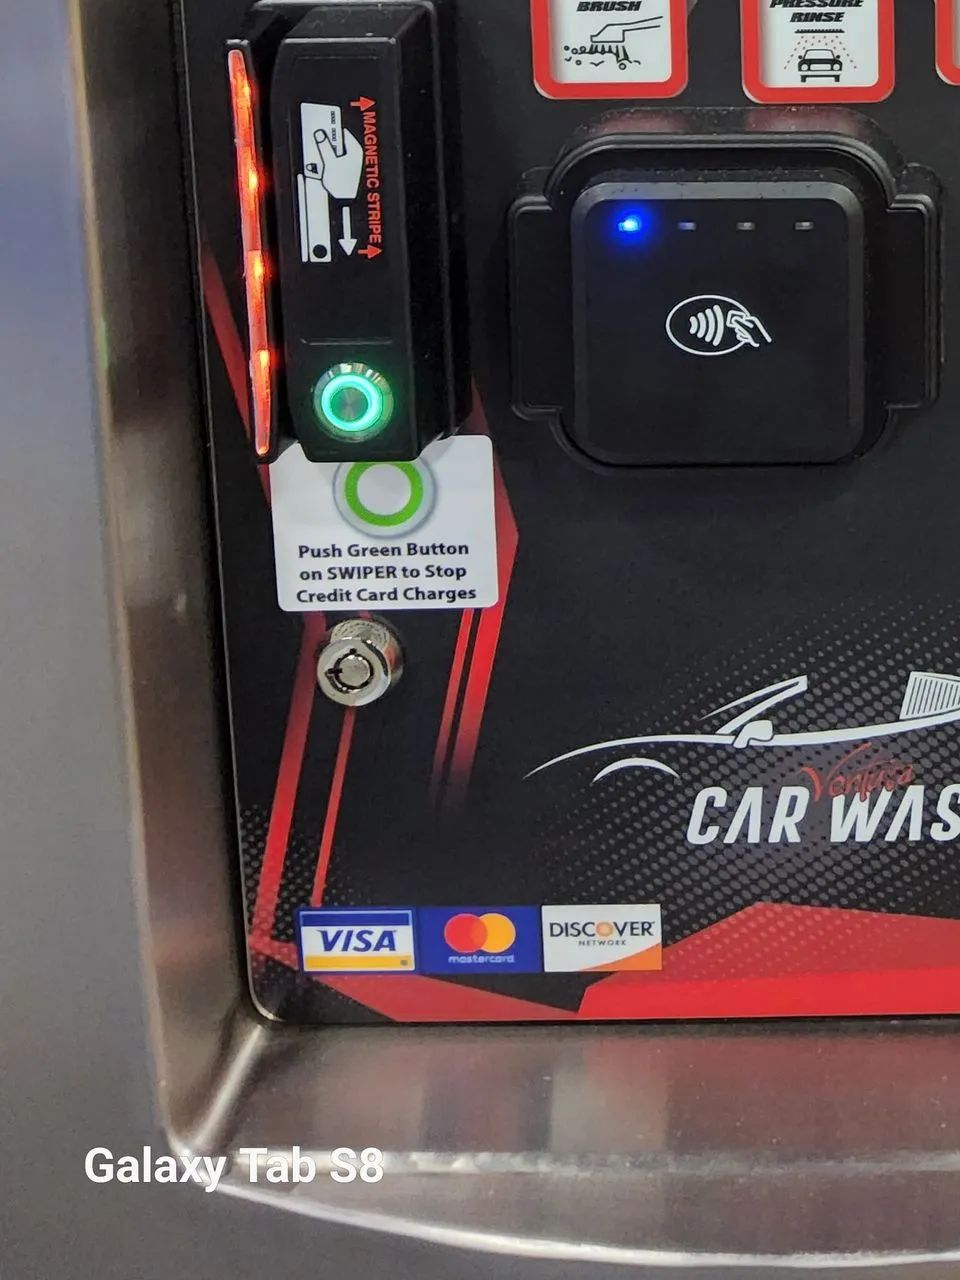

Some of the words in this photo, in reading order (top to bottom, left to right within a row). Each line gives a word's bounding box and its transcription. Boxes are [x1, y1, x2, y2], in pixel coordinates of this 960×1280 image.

[576, 1, 642, 12] BRUSH
[790, 12, 845, 23] RINSE
[362, 111, 380, 189] MAGNETIC
[367, 192, 383, 244] STRIPE
[298, 544, 342, 558] Push
[347, 544, 401, 557] Green
[406, 542, 469, 556] Button
[300, 569, 322, 580] on
[327, 565, 396, 580] SWIPER
[401, 566, 420, 578] to
[424, 564, 467, 581] Stop
[296, 588, 352, 603] Credit
[356, 588, 398, 601] Card
[403, 587, 476, 603] Charges
[686, 786, 803, 844] CAR
[549, 921, 654, 938] DISCOVER
[316, 930, 397, 952] VISA
[448, 954, 515, 964] mastercard
